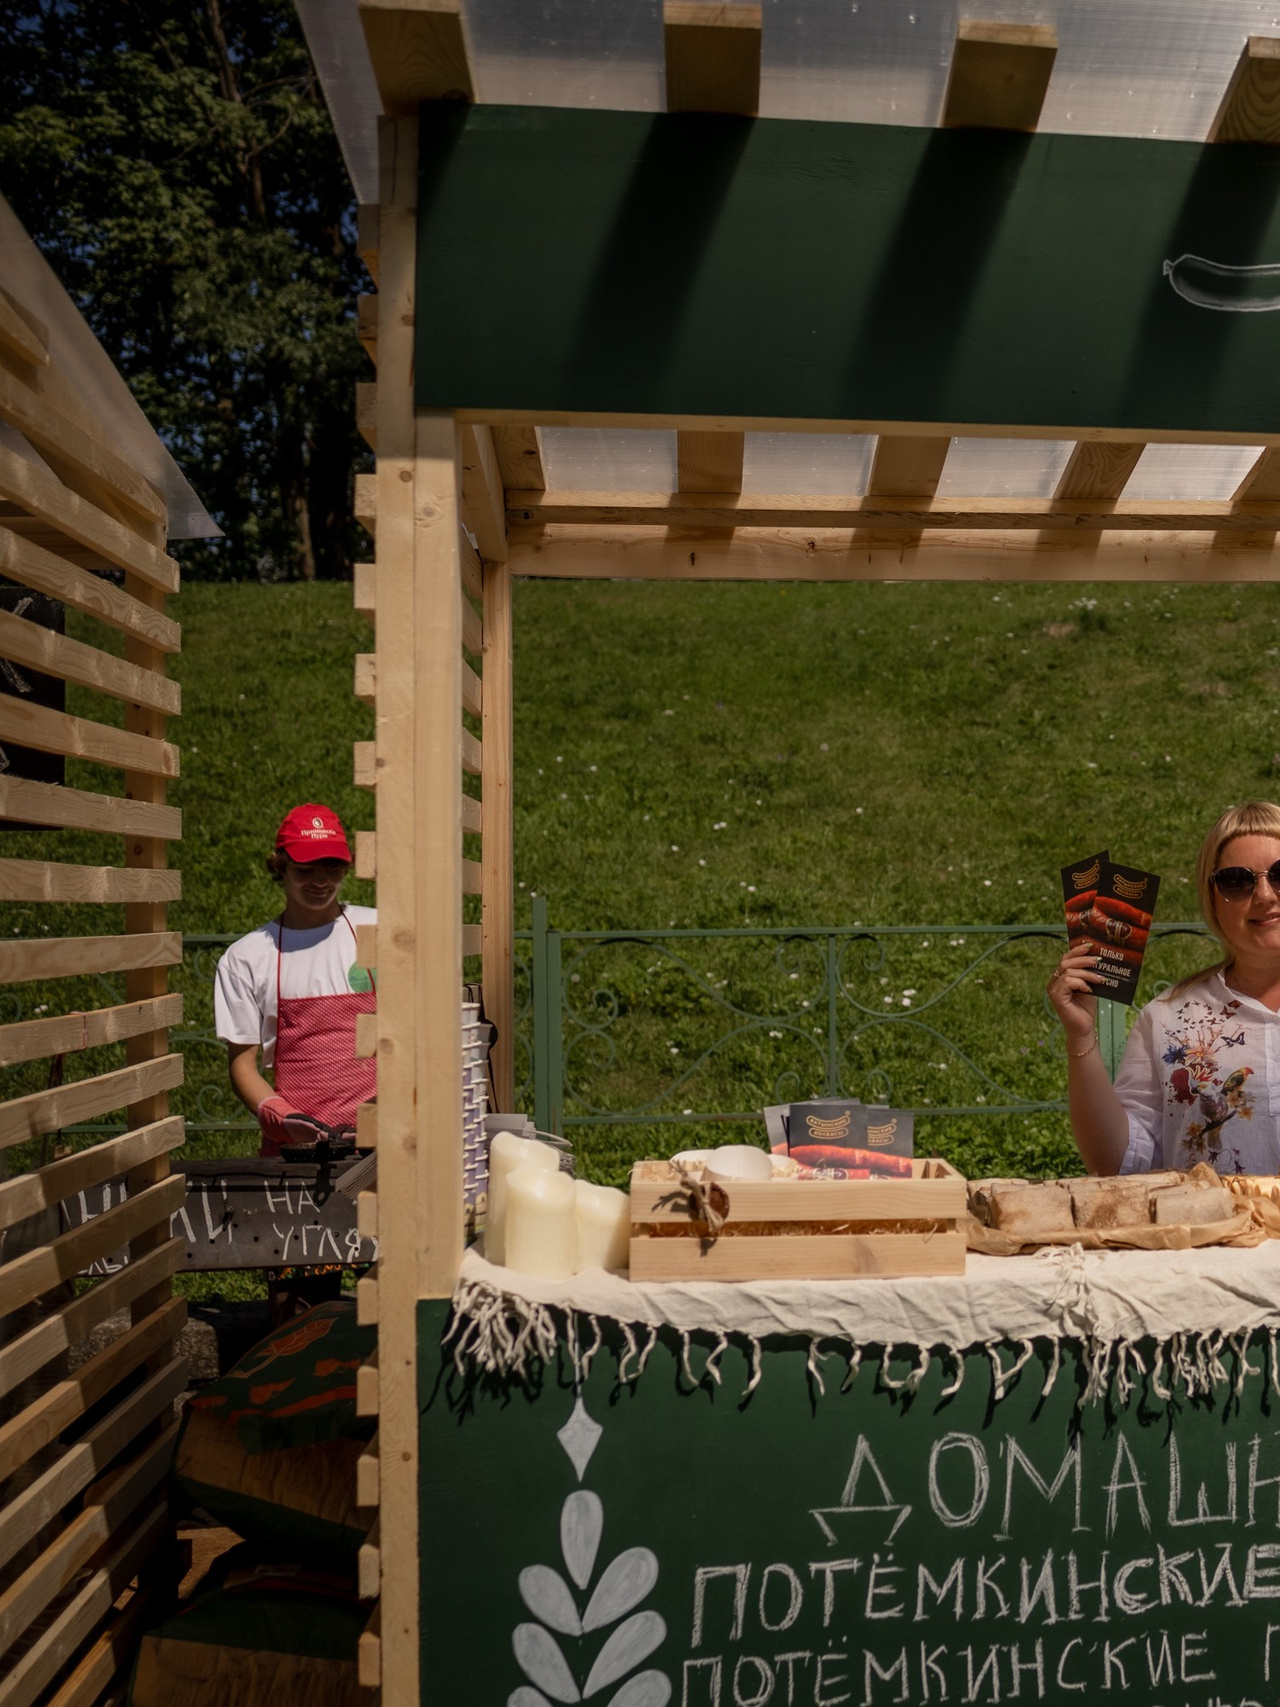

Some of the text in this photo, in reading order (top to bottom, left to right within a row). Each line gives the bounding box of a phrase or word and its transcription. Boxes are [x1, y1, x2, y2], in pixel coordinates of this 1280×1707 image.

[1100, 947, 1124, 961] ТОЛЬКО
[1092, 962, 1131, 977] ТУРАЛЬНОЕ
[264, 1180, 321, 1215] НА
[681, 1630, 1217, 1707] ПОТЁМКИНСКИЕ
